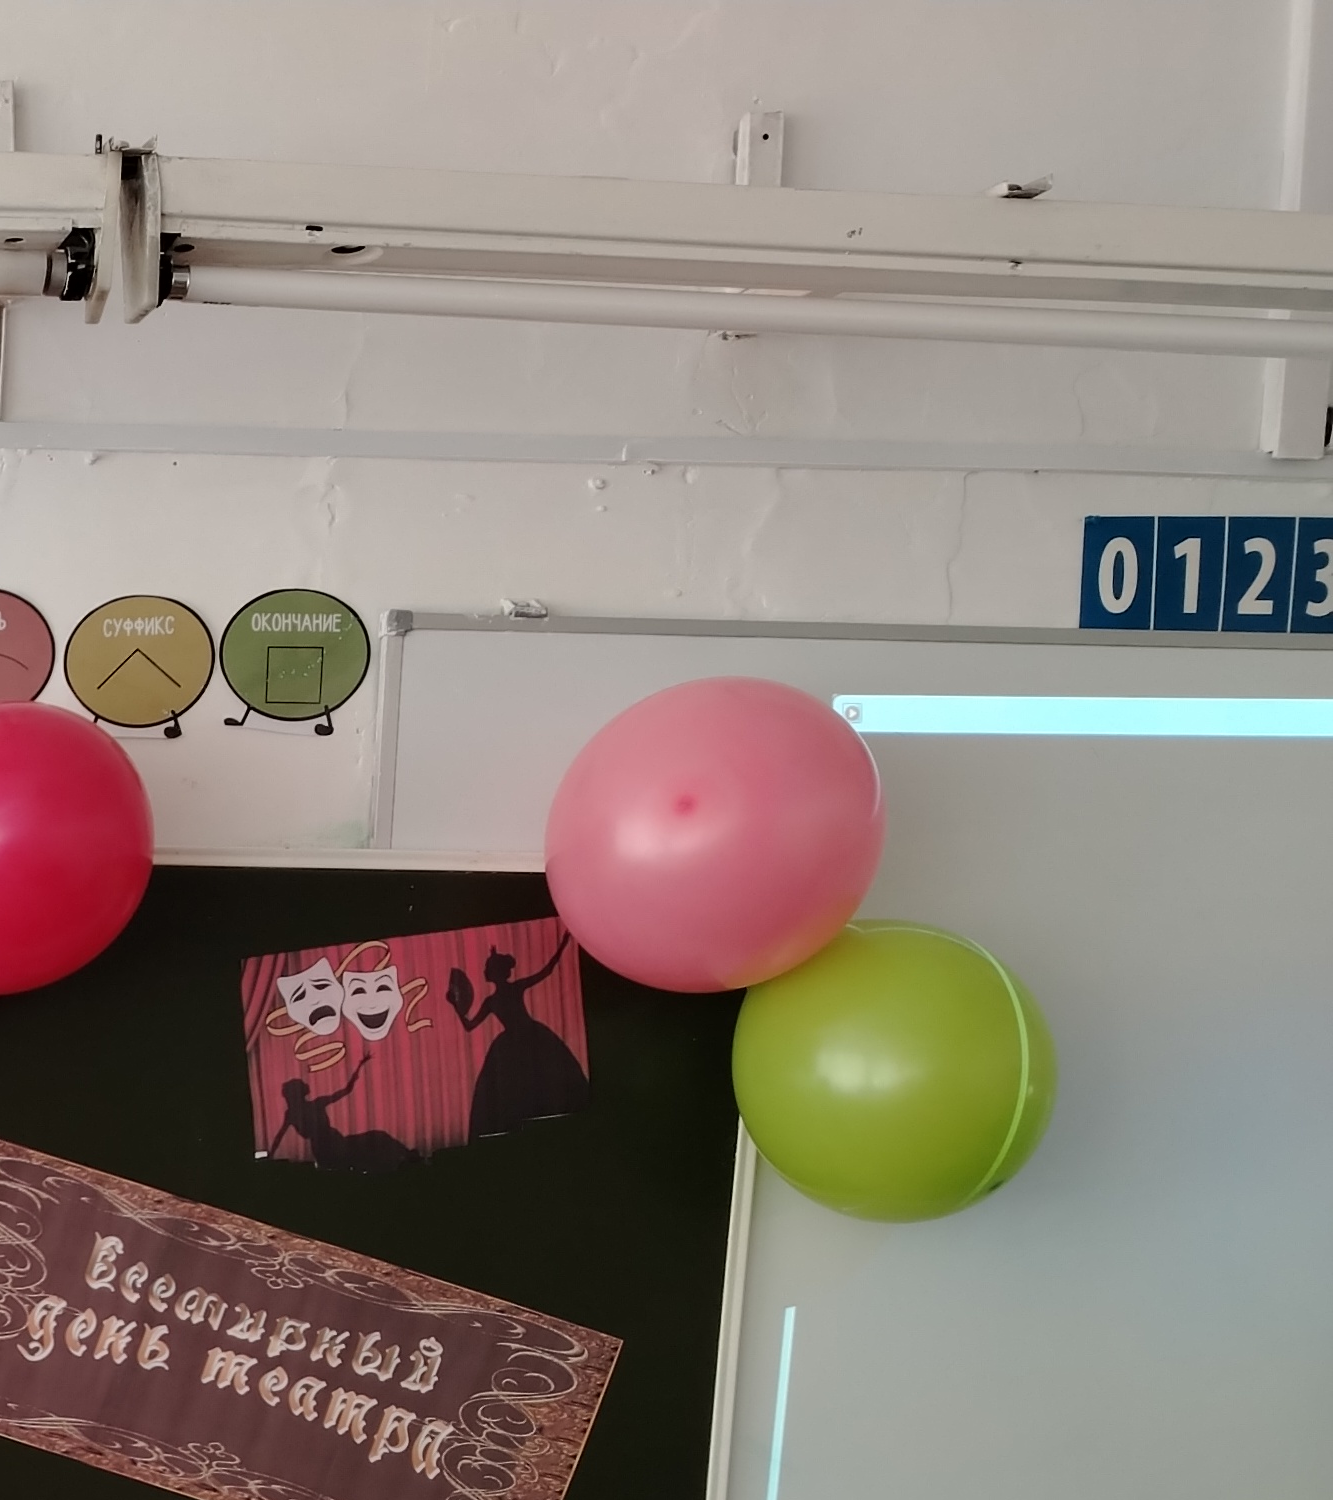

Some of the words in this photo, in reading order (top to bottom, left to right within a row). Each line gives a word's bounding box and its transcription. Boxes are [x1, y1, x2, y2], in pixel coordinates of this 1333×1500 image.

[103, 615, 175, 640] СУФФИКС
[251, 612, 342, 636] ОКОНЧАНИЕ
[84, 1231, 445, 1394] Всемирный
[16, 1297, 171, 1371] день
[200, 1346, 455, 1480] театра
